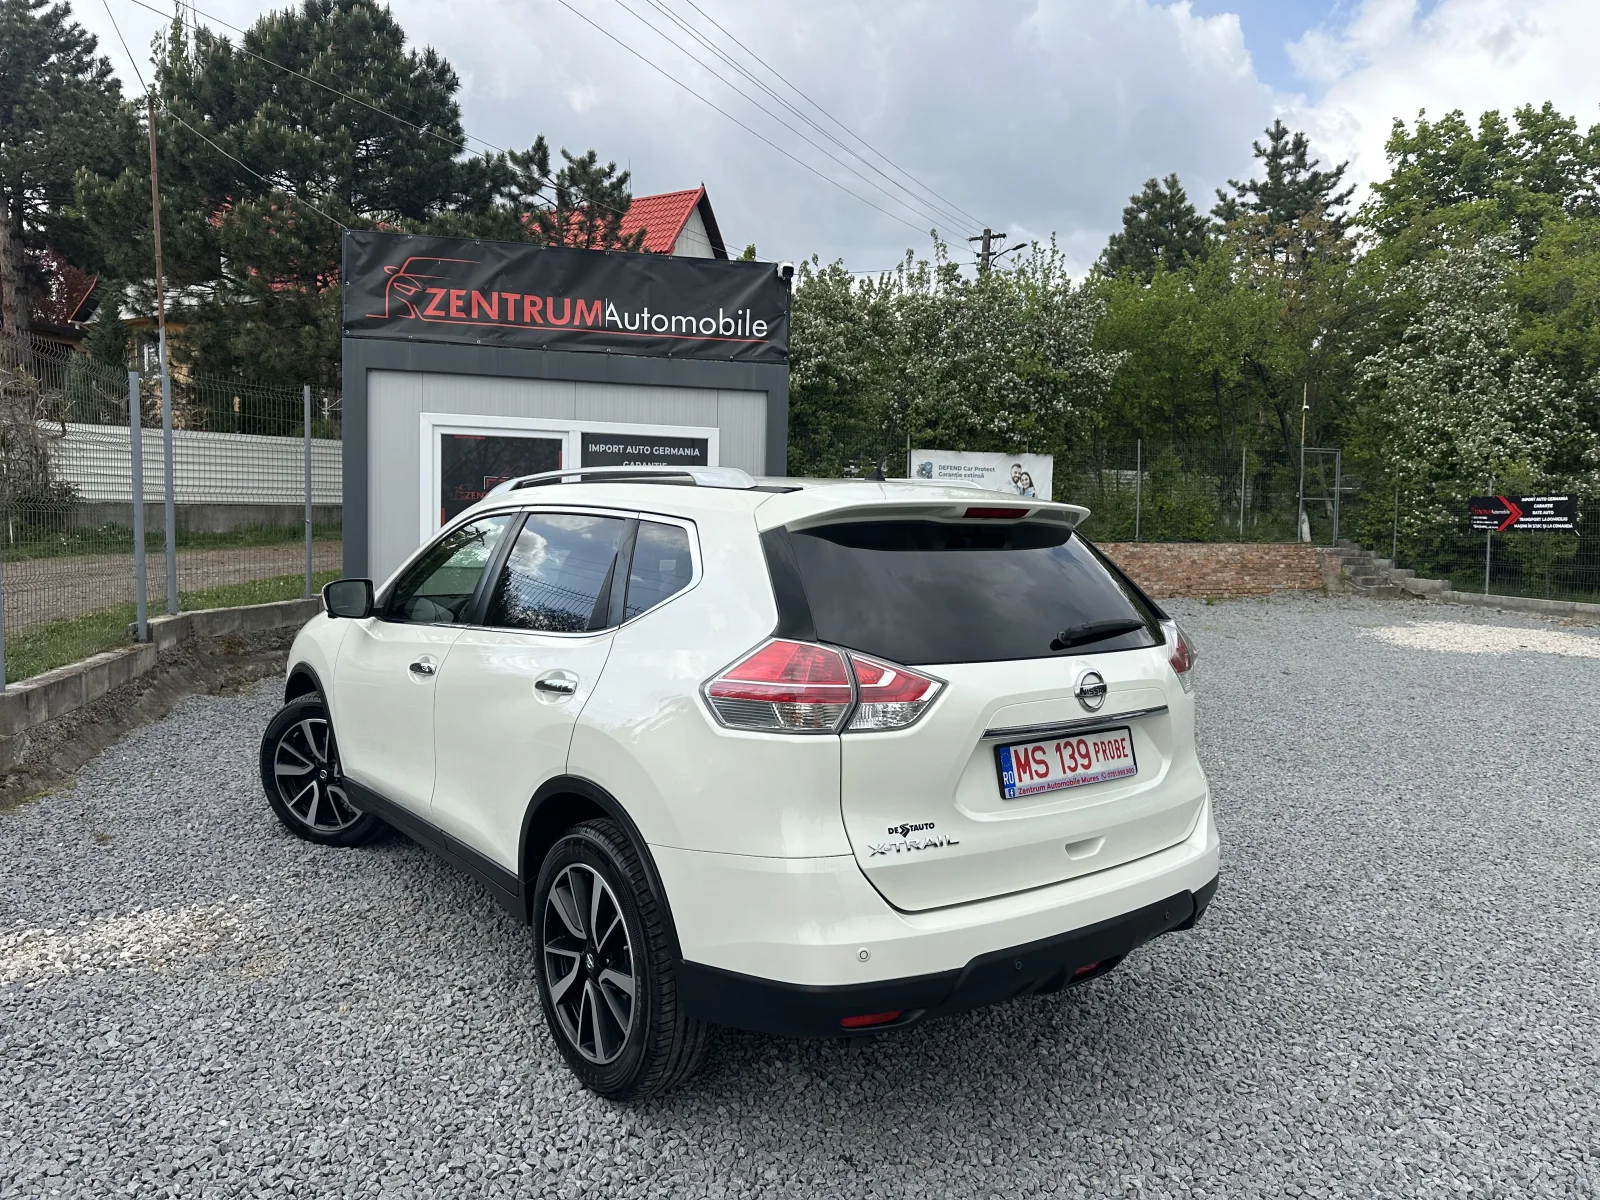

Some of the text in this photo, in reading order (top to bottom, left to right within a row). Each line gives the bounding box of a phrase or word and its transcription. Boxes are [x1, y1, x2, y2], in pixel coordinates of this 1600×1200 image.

[423, 287, 769, 338] ZENTRUM Automobile
[588, 443, 700, 456] IMPORT AUTO GERMANIA
[1013, 737, 1129, 783] MS 139 PROBE
[1003, 771, 1015, 785] RO
[1018, 785, 1046, 796] Zentrum
[1047, 778, 1080, 790] Automobile
[1081, 775, 1100, 786] Mures
[867, 834, 960, 857] X-TRAIL
